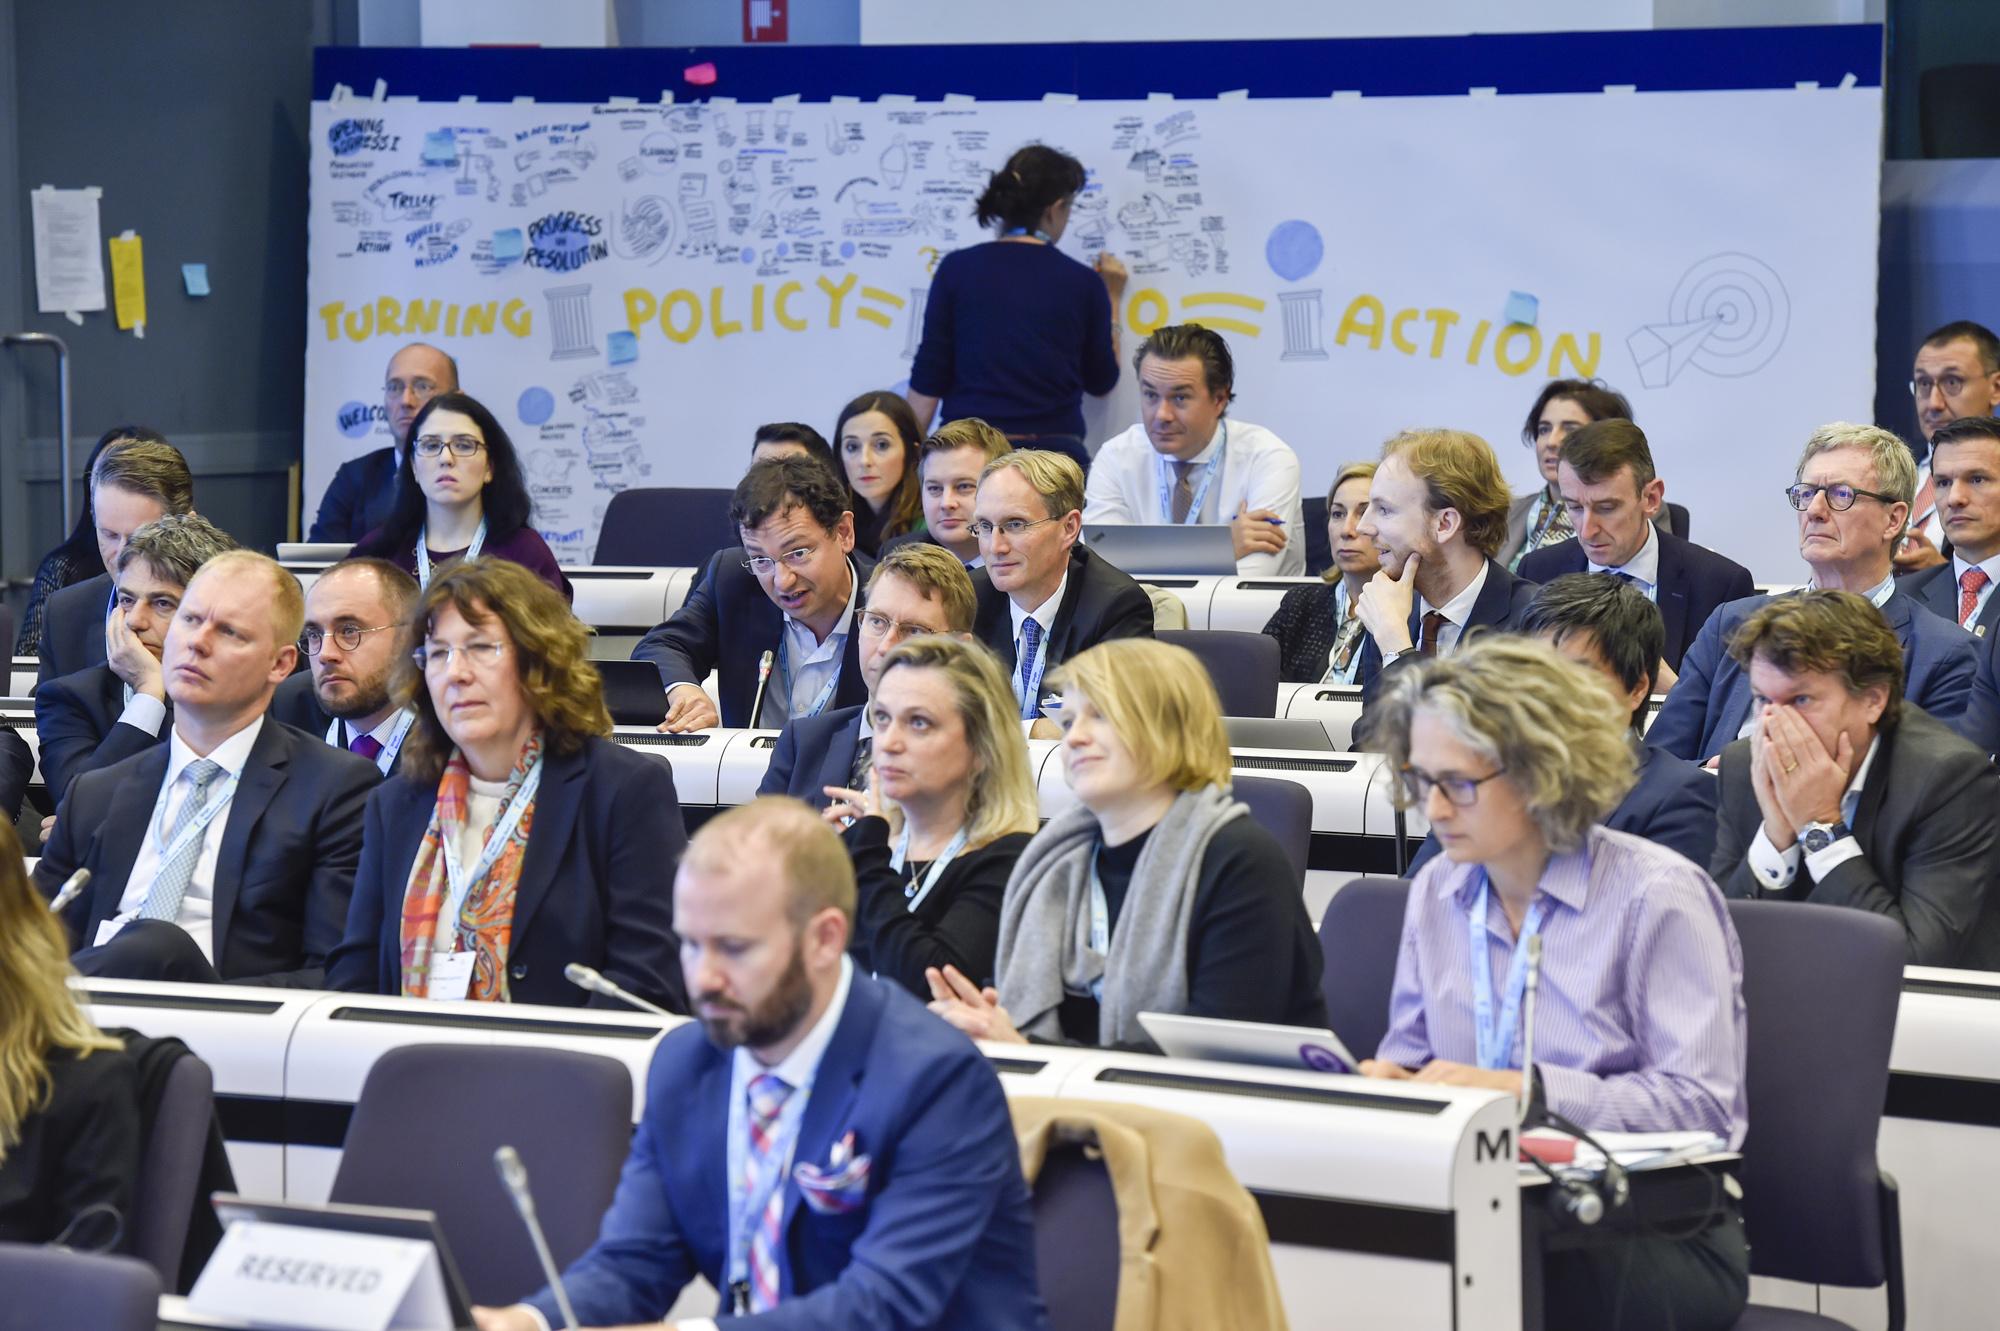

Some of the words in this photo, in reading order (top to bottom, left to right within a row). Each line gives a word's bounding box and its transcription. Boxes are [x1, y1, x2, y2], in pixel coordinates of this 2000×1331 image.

[528, 211, 603, 241] PROGRESS
[524, 240, 609, 272] RESOLUTION
[319, 295, 533, 343] TURNING
[622, 272, 858, 344] POLICY
[1334, 293, 1602, 379] ACTION
[339, 404, 390, 431] WELCO
[1476, 1128, 1512, 1164] M
[236, 1253, 384, 1295] RESERVED
